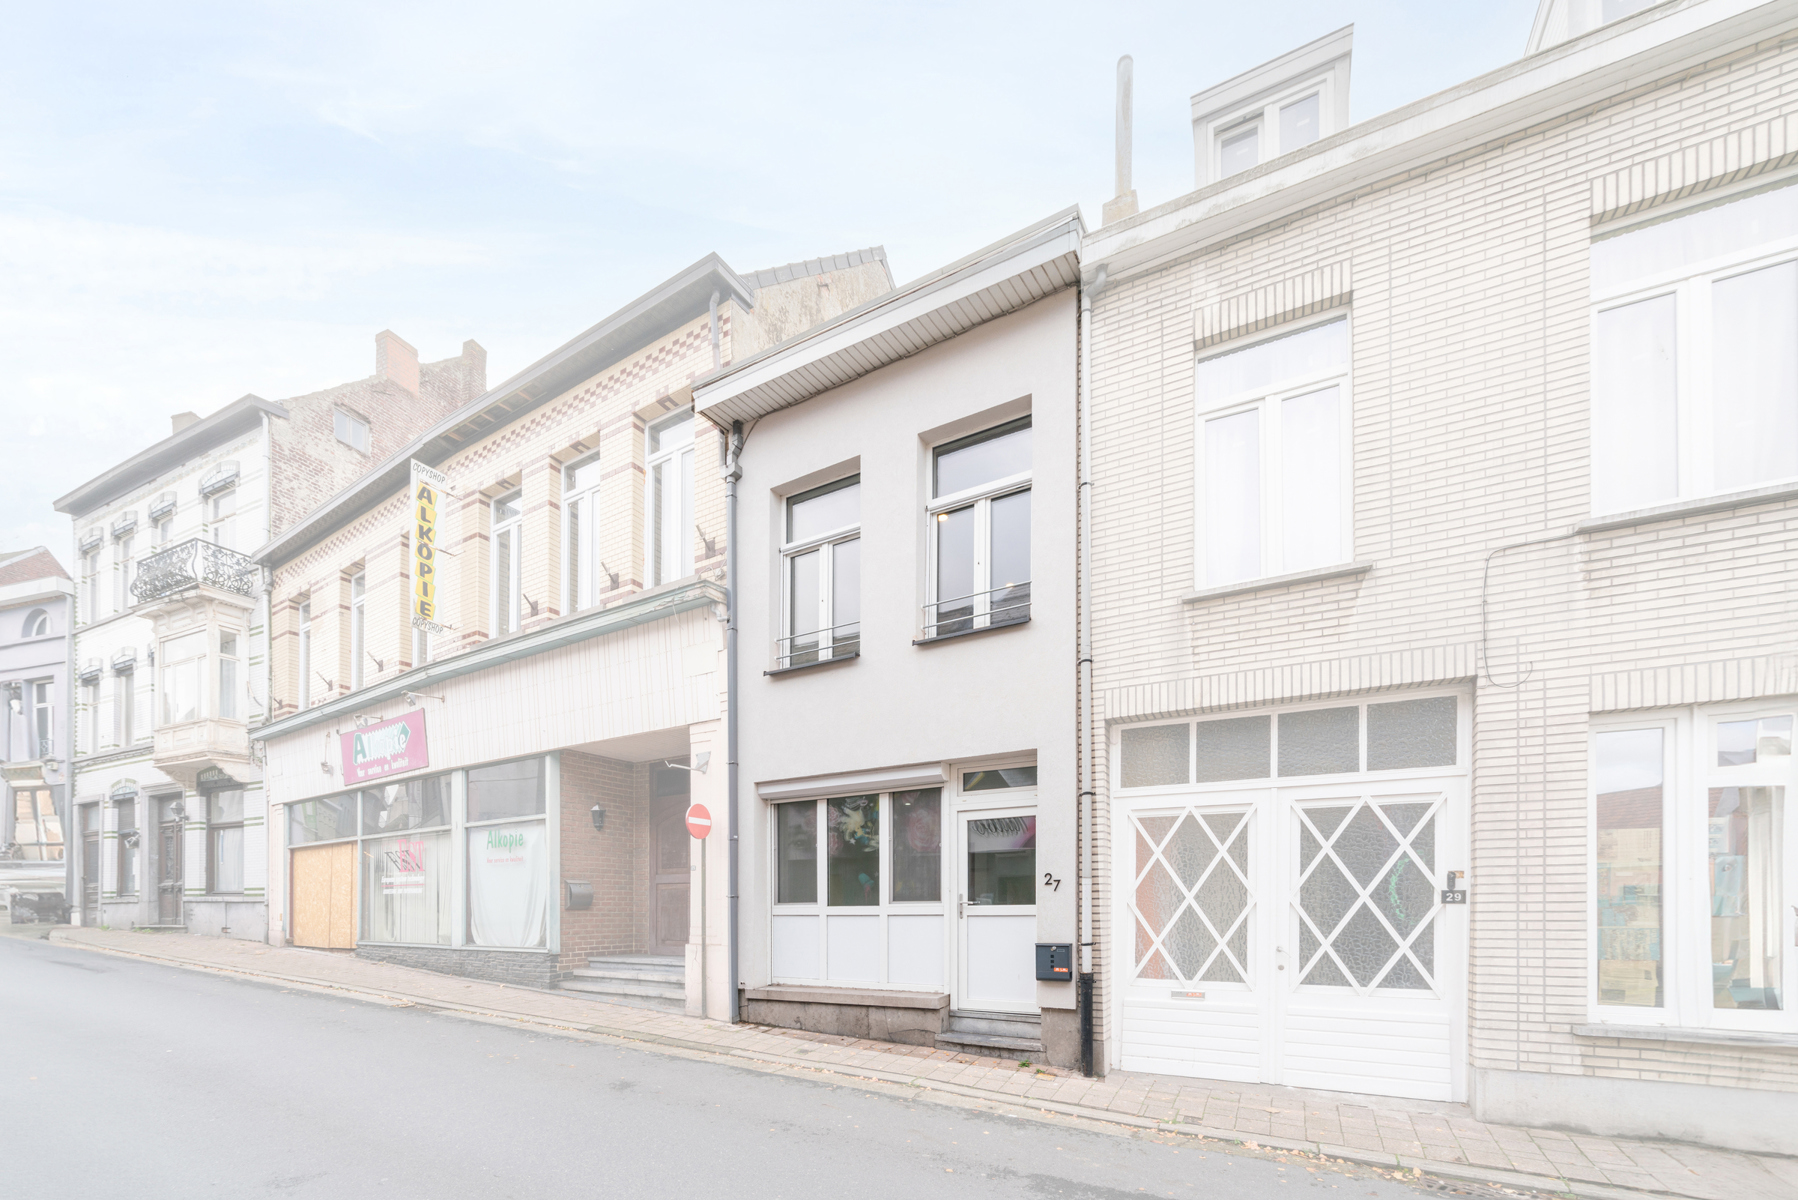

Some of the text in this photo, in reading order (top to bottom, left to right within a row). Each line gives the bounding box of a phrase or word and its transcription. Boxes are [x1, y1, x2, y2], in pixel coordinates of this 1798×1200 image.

[412, 462, 446, 484] COPYSHOP
[416, 485, 433, 618] ALKOPIE
[412, 616, 444, 634] COPYSHOP
[353, 727, 408, 765] Alkopie
[486, 829, 524, 853] Alkopie
[1044, 872, 1061, 892] 27
[1445, 892, 1462, 902] 29
